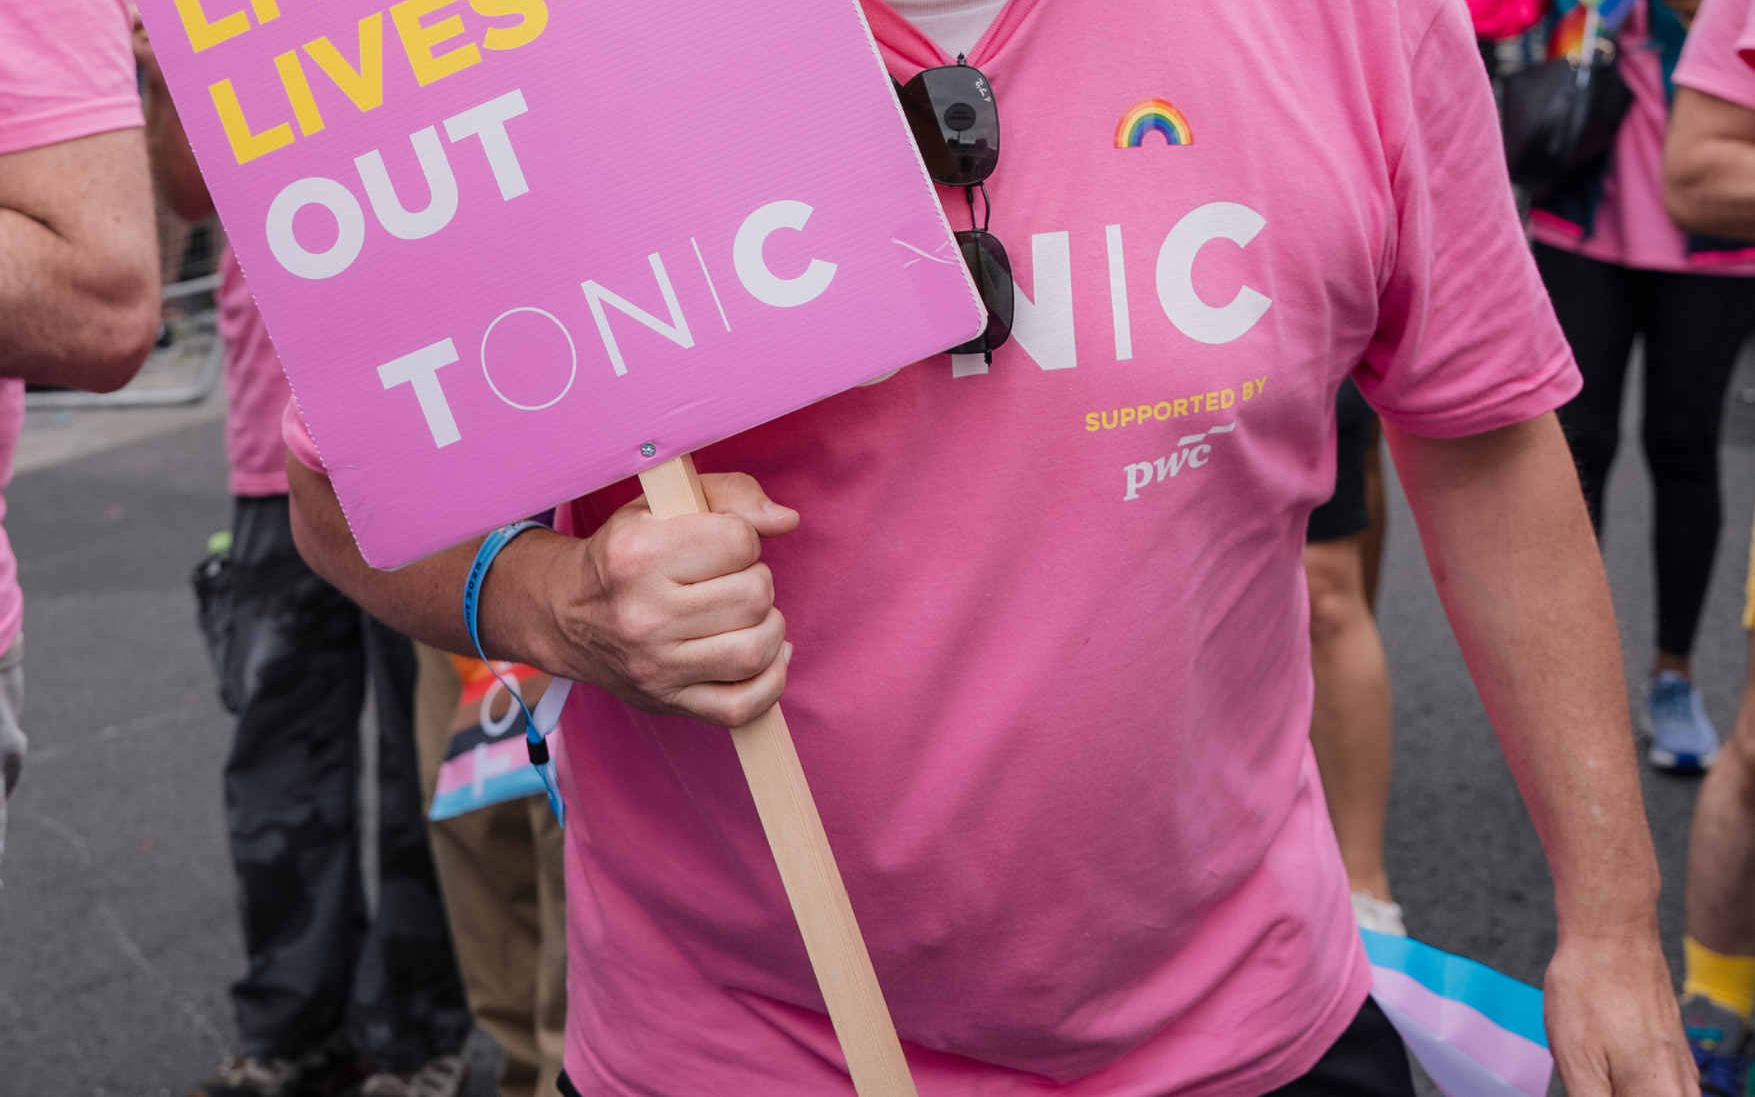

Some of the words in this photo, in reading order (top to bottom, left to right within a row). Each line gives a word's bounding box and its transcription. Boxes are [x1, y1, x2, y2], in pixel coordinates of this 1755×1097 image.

[265, 88, 530, 280] OUT
[376, 199, 838, 449] TONIC
[1085, 387, 1236, 432] SUPPORTED
[1242, 376, 1269, 402] BY
[1122, 433, 1215, 502] pwc
[465, 560, 483, 601] 2025
